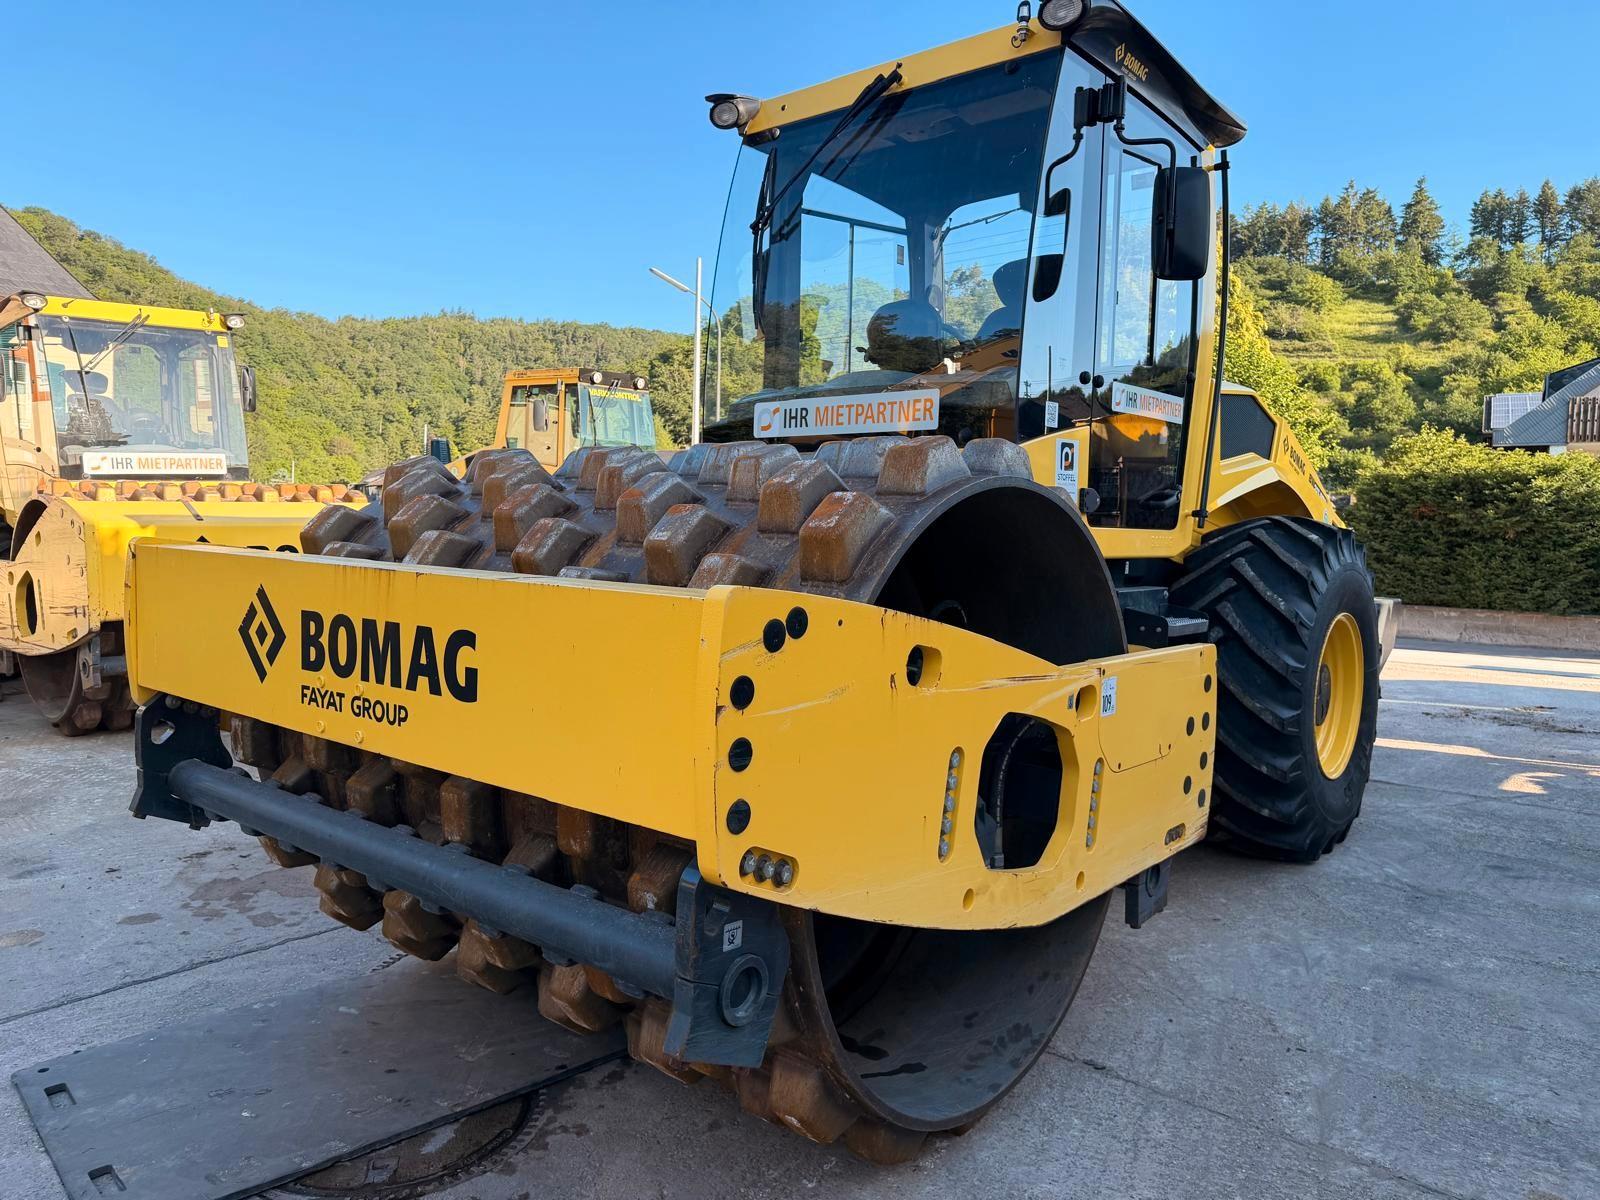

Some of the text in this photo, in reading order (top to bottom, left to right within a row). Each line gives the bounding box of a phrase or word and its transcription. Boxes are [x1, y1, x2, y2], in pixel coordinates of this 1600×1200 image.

[1123, 52, 1148, 81] BOMAG
[783, 398, 935, 429] IHR MIETPARTNER
[1125, 390, 1182, 417] IHR MIETPARTNER
[111, 457, 224, 470] IHR MIETPARTNER
[300, 609, 479, 704] BOMAG
[300, 684, 409, 727] FAYAT GROUP
